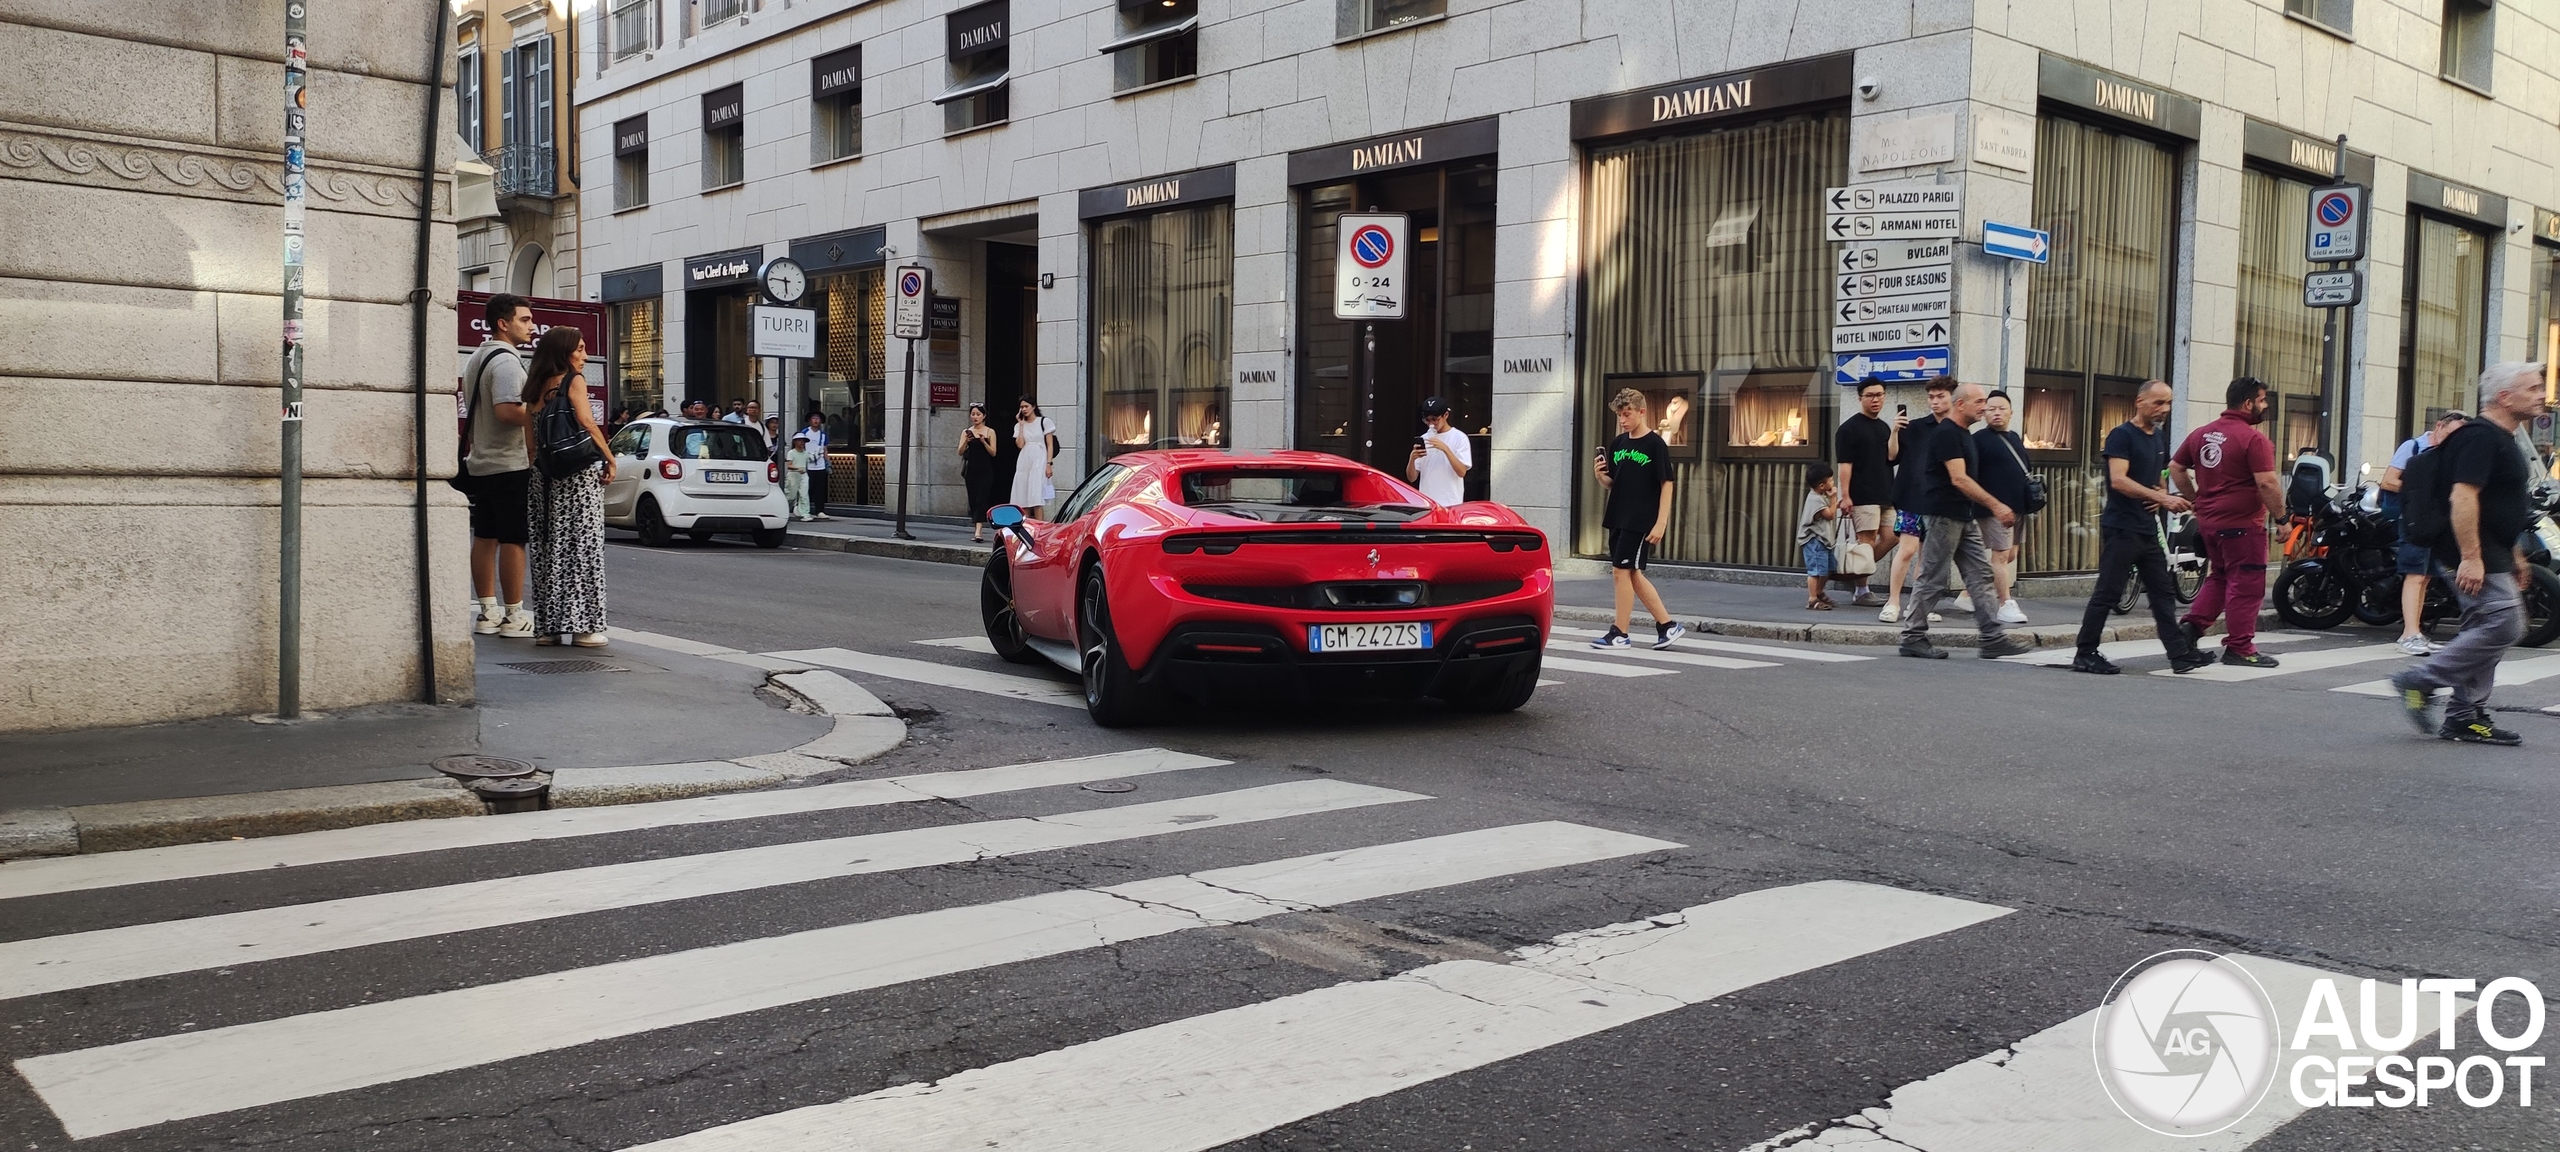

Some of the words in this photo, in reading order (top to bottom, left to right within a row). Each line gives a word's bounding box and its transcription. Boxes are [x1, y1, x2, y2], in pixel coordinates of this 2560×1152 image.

[960, 21, 1001, 50] DAMIANI
[822, 66, 855, 90] DAMIANI
[1652, 79, 1752, 122] DAMIANI
[2095, 78, 2156, 121] DAMIANI
[711, 102, 739, 124] DAMIANI
[621, 131, 645, 149] DAMIANI
[2001, 127, 2009, 136] VIA
[1353, 137, 1423, 171] DAMIANI
[1862, 145, 1948, 167] NAPOLEONE
[2001, 145, 2027, 160] ANDREA
[2290, 139, 2336, 175] DAMIANI
[1126, 180, 1180, 208] DAMIANI
[1879, 192, 1920, 204] PALAZZO
[1922, 191, 1954, 203] PARIGI
[2442, 186, 2478, 216] DAMIANI
[1880, 220, 1922, 231] ARMANI
[1925, 219, 1957, 229] HOTEL
[2318, 234, 2328, 246] P
[1907, 245, 1949, 260] BVLGARI
[692, 267, 705, 280] Van
[705, 263, 723, 279] Cleef
[722, 265, 728, 277] &
[728, 259, 750, 279] Arpels
[1043, 274, 1051, 286] 10
[1352, 276, 1361, 287] 0
[1372, 276, 1390, 288] 24
[1879, 276, 1903, 289] FOUR
[1905, 272, 1947, 287] SEASONS
[2331, 276, 2344, 284] 24
[933, 303, 957, 311] DAMIANI
[1877, 304, 1910, 315] CHATEAU
[1911, 301, 1948, 313] MONFORT
[761, 316, 808, 333] TURRI
[933, 319, 957, 327] DAMIANI
[1836, 333, 1865, 344] HOTEL
[1868, 329, 1901, 342] INDIGO
[1504, 357, 1552, 374] DAMIANI
[1240, 370, 1276, 384] DAMIANI
[933, 385, 957, 393] VENINI
[1324, 626, 1349, 648] GM
[1356, 624, 1418, 647] 242ZS
